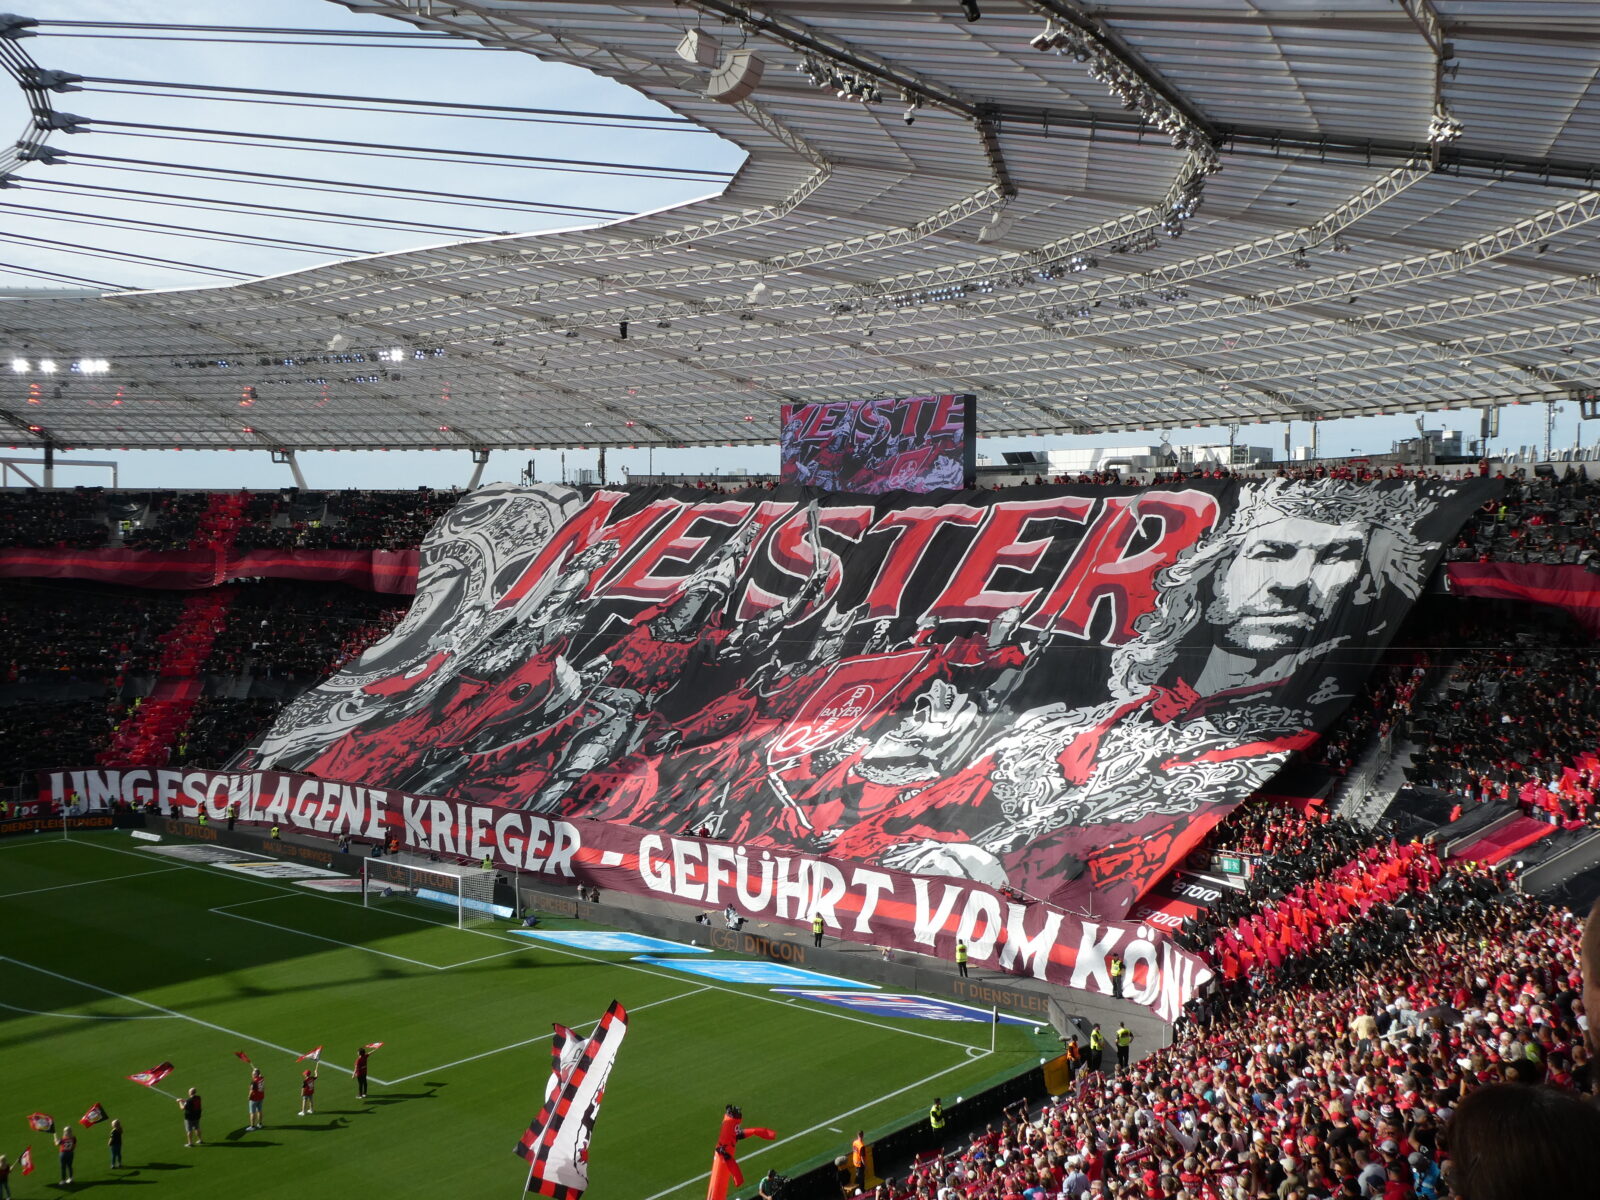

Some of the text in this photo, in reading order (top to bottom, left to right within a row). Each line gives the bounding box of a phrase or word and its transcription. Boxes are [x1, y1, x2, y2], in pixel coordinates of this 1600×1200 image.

[491, 488, 1222, 649] MEISTER
[820, 706, 863, 718] BAYER
[0, 816, 113, 834] DIENSTLEISTUNGEN
[49, 769, 388, 840] UNGESCHLAGENE
[402, 796, 582, 878] KRIEGER
[639, 834, 895, 935] GEFÜHRT
[911, 877, 1065, 982] VOM
[743, 934, 806, 964] DITCON
[953, 979, 966, 995] IT
